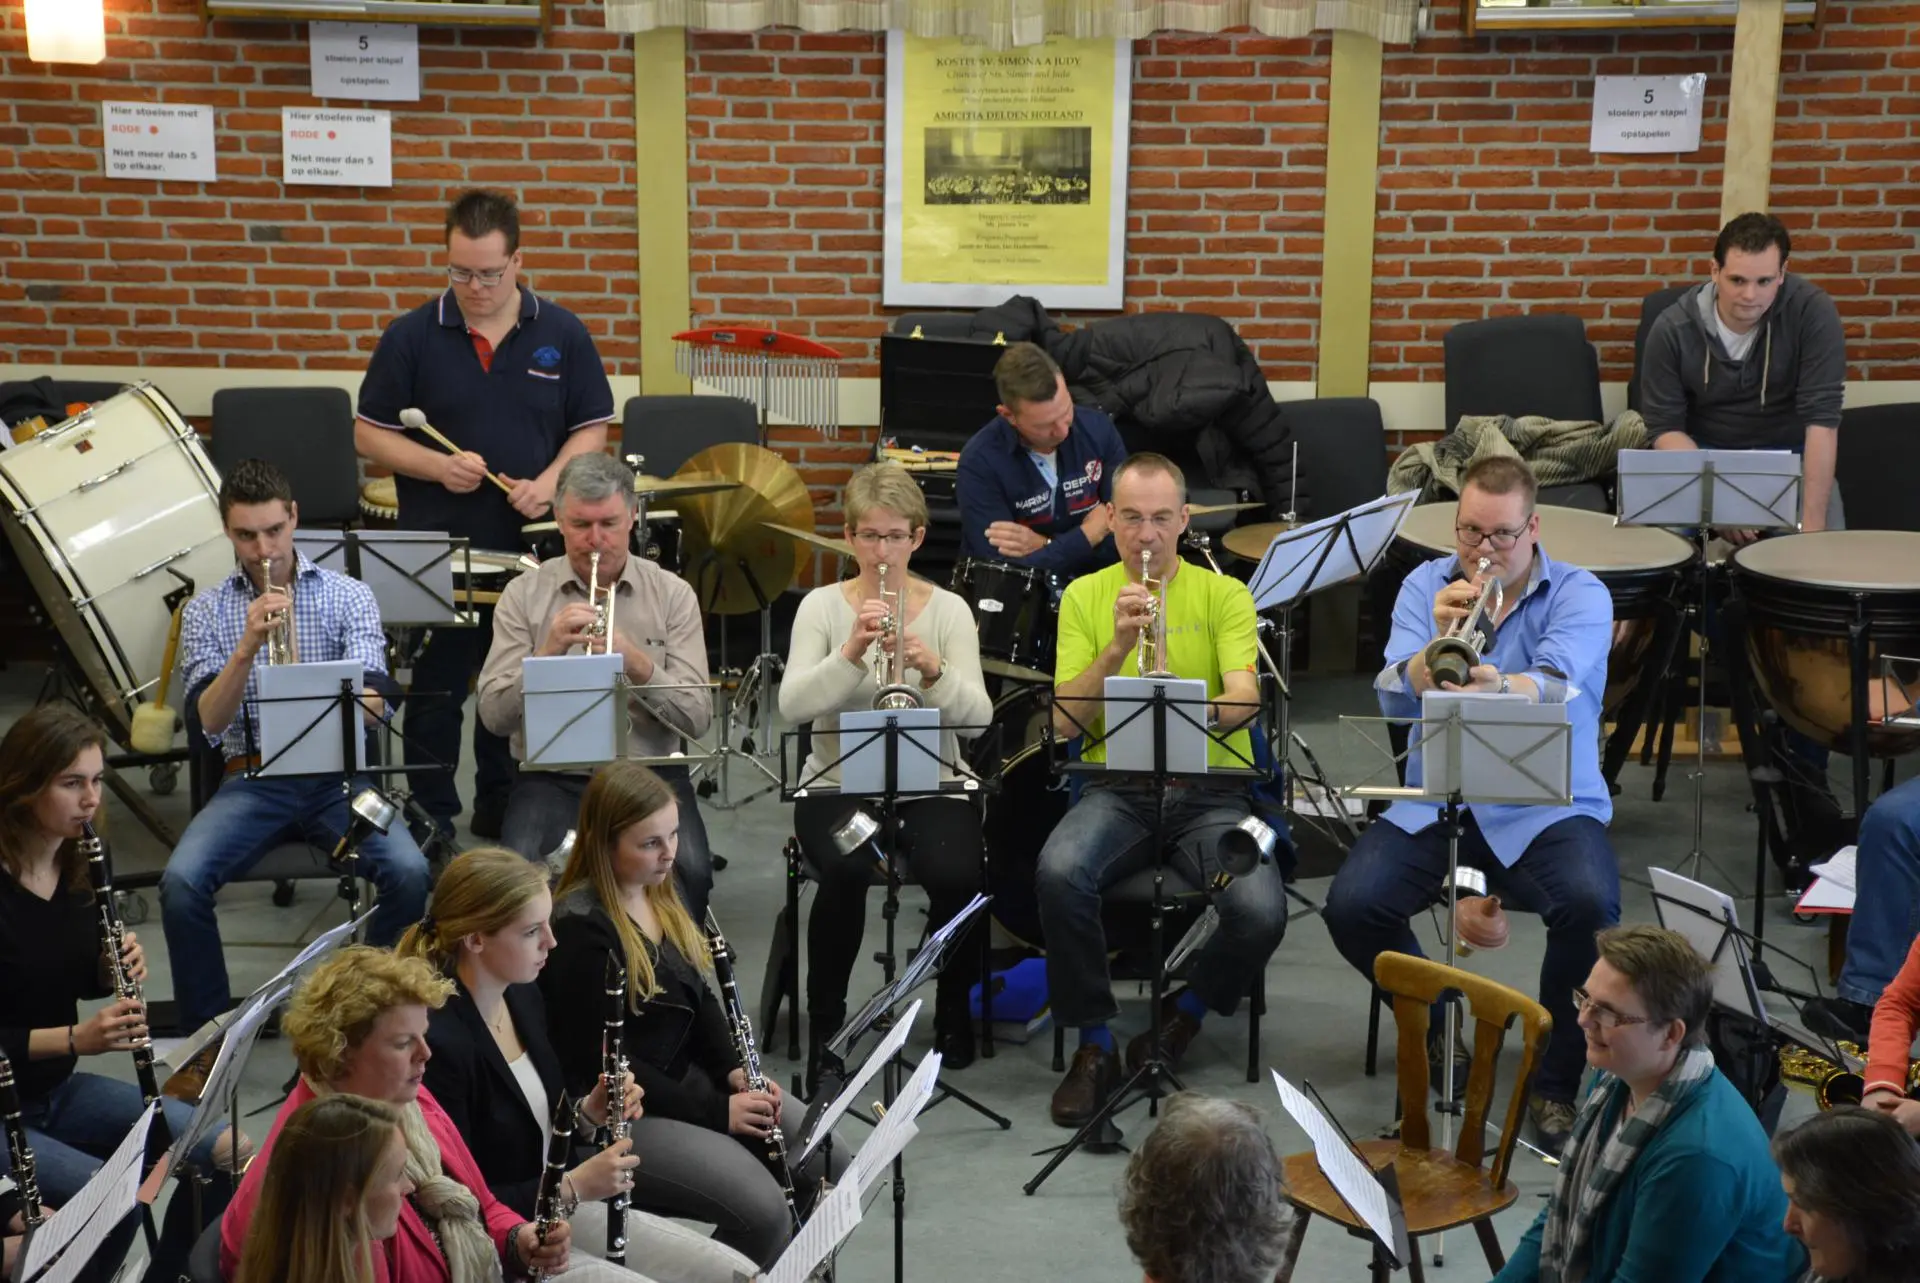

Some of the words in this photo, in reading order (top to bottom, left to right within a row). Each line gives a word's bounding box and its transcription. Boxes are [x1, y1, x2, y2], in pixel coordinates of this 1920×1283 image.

[358, 35, 368, 50] 5
[1053, 57, 1081, 68] JUDY
[1644, 89, 1654, 104] 5
[111, 106, 132, 115] Hier
[136, 108, 175, 117] stoelen
[178, 110, 199, 118] met
[290, 112, 311, 120] Hier
[315, 113, 353, 122] stoelen
[356, 115, 376, 123] met
[1031, 110, 1083, 121] HOLLAND
[1643, 110, 1658, 118] per
[1620, 130, 1671, 139] opstapelen
[113, 148, 134, 158] Niet
[138, 150, 165, 159] meer
[168, 150, 188, 160] dan
[190, 152, 198, 160] 5
[291, 155, 312, 163] Niet
[315, 156, 342, 164] meer
[345, 155, 364, 165] dan
[367, 157, 374, 165] 5
[113, 163, 127, 172] op
[291, 168, 305, 177] op
[1062, 475, 1092, 491] DEPT
